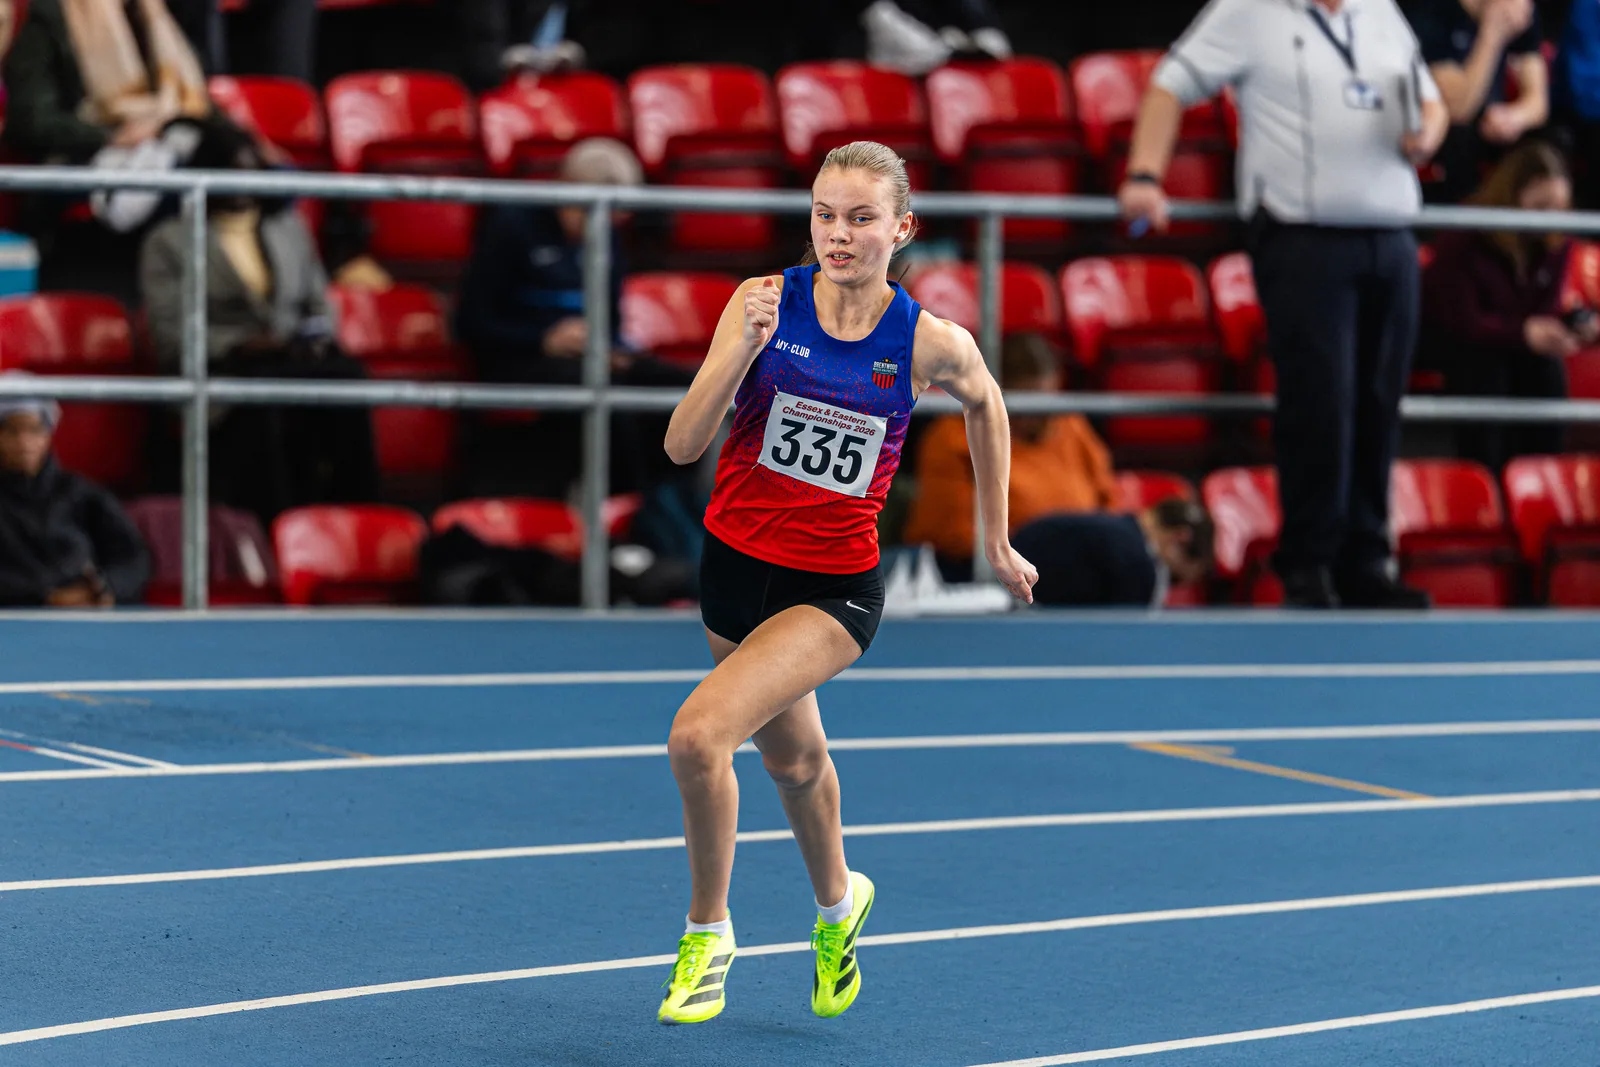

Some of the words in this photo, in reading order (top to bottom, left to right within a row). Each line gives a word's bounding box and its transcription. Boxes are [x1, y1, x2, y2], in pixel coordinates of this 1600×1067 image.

[782, 406, 852, 430] Championships
[853, 425, 876, 436] 2026
[795, 401, 823, 414] Essex
[832, 411, 867, 425] Eastern
[771, 418, 867, 485] 335
